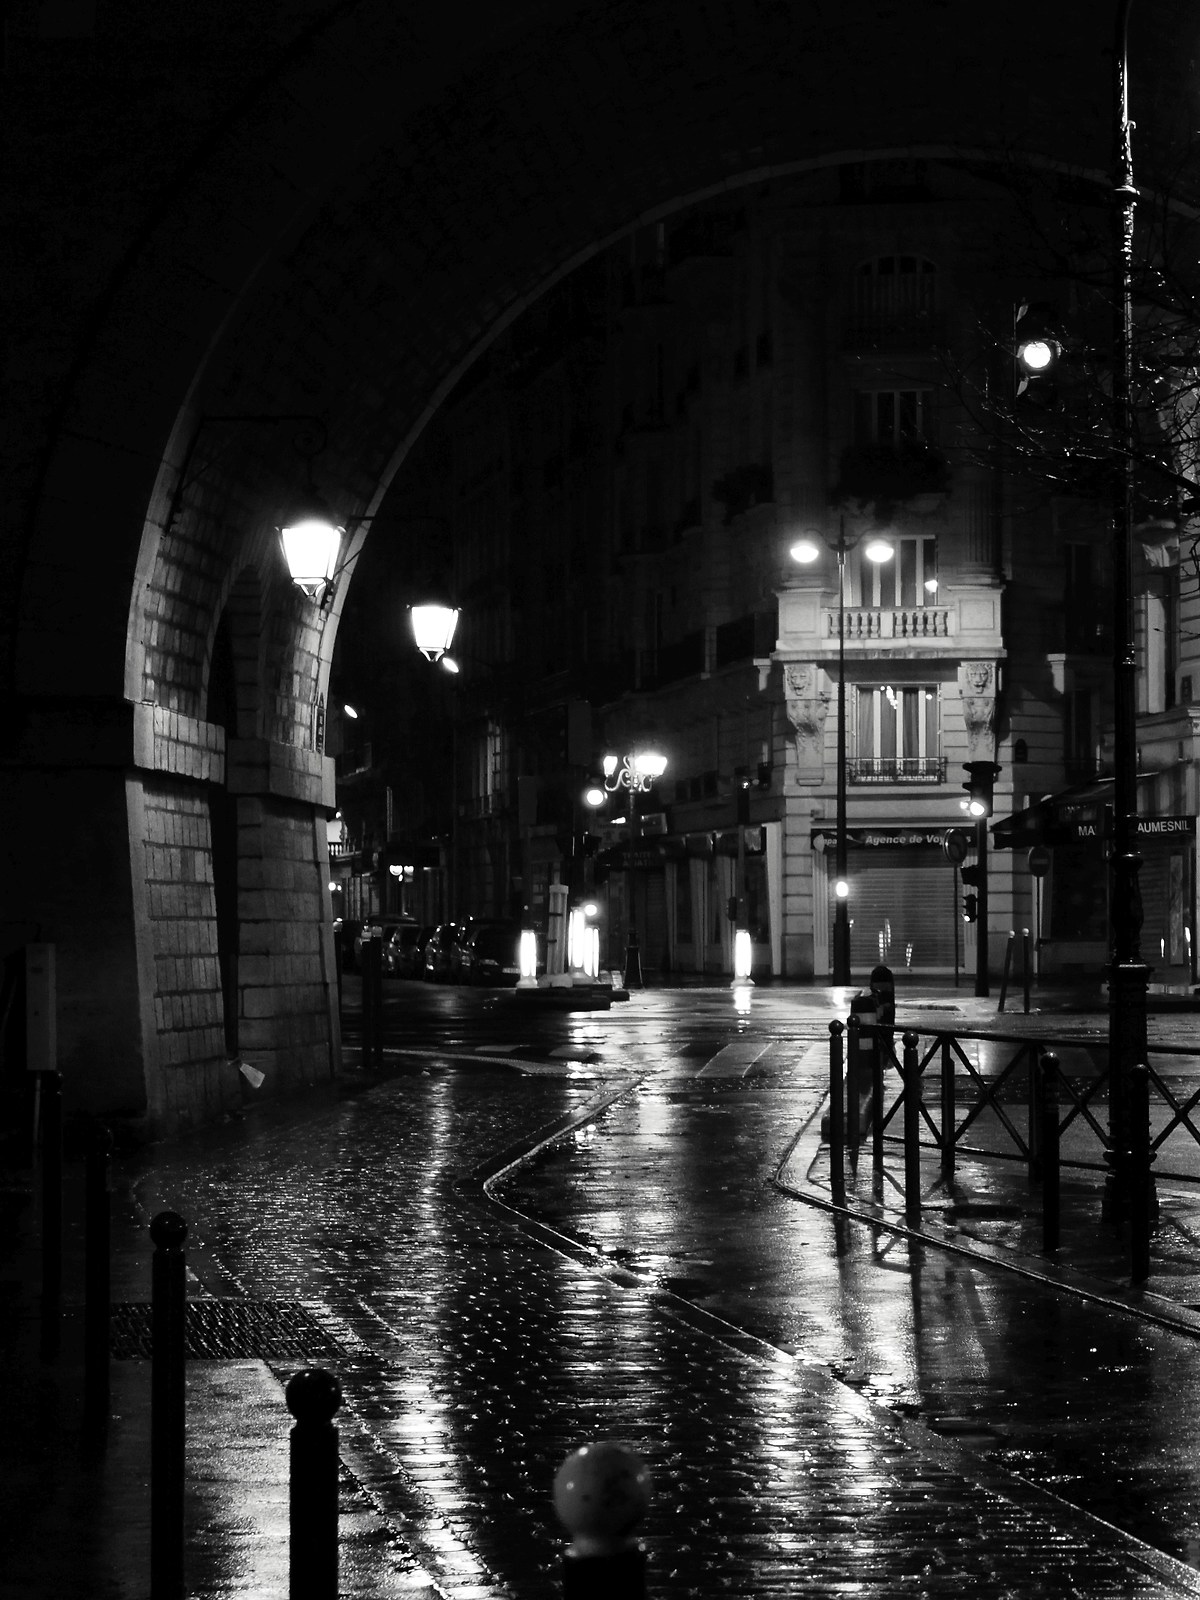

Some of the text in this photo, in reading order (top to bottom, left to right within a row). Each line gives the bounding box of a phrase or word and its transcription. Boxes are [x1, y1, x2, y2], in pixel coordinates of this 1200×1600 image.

[1137, 820, 1191, 833] AUMESNIL
[865, 835, 906, 846] Agence
[909, 834, 923, 844] de
[926, 834, 972, 846] Voys
